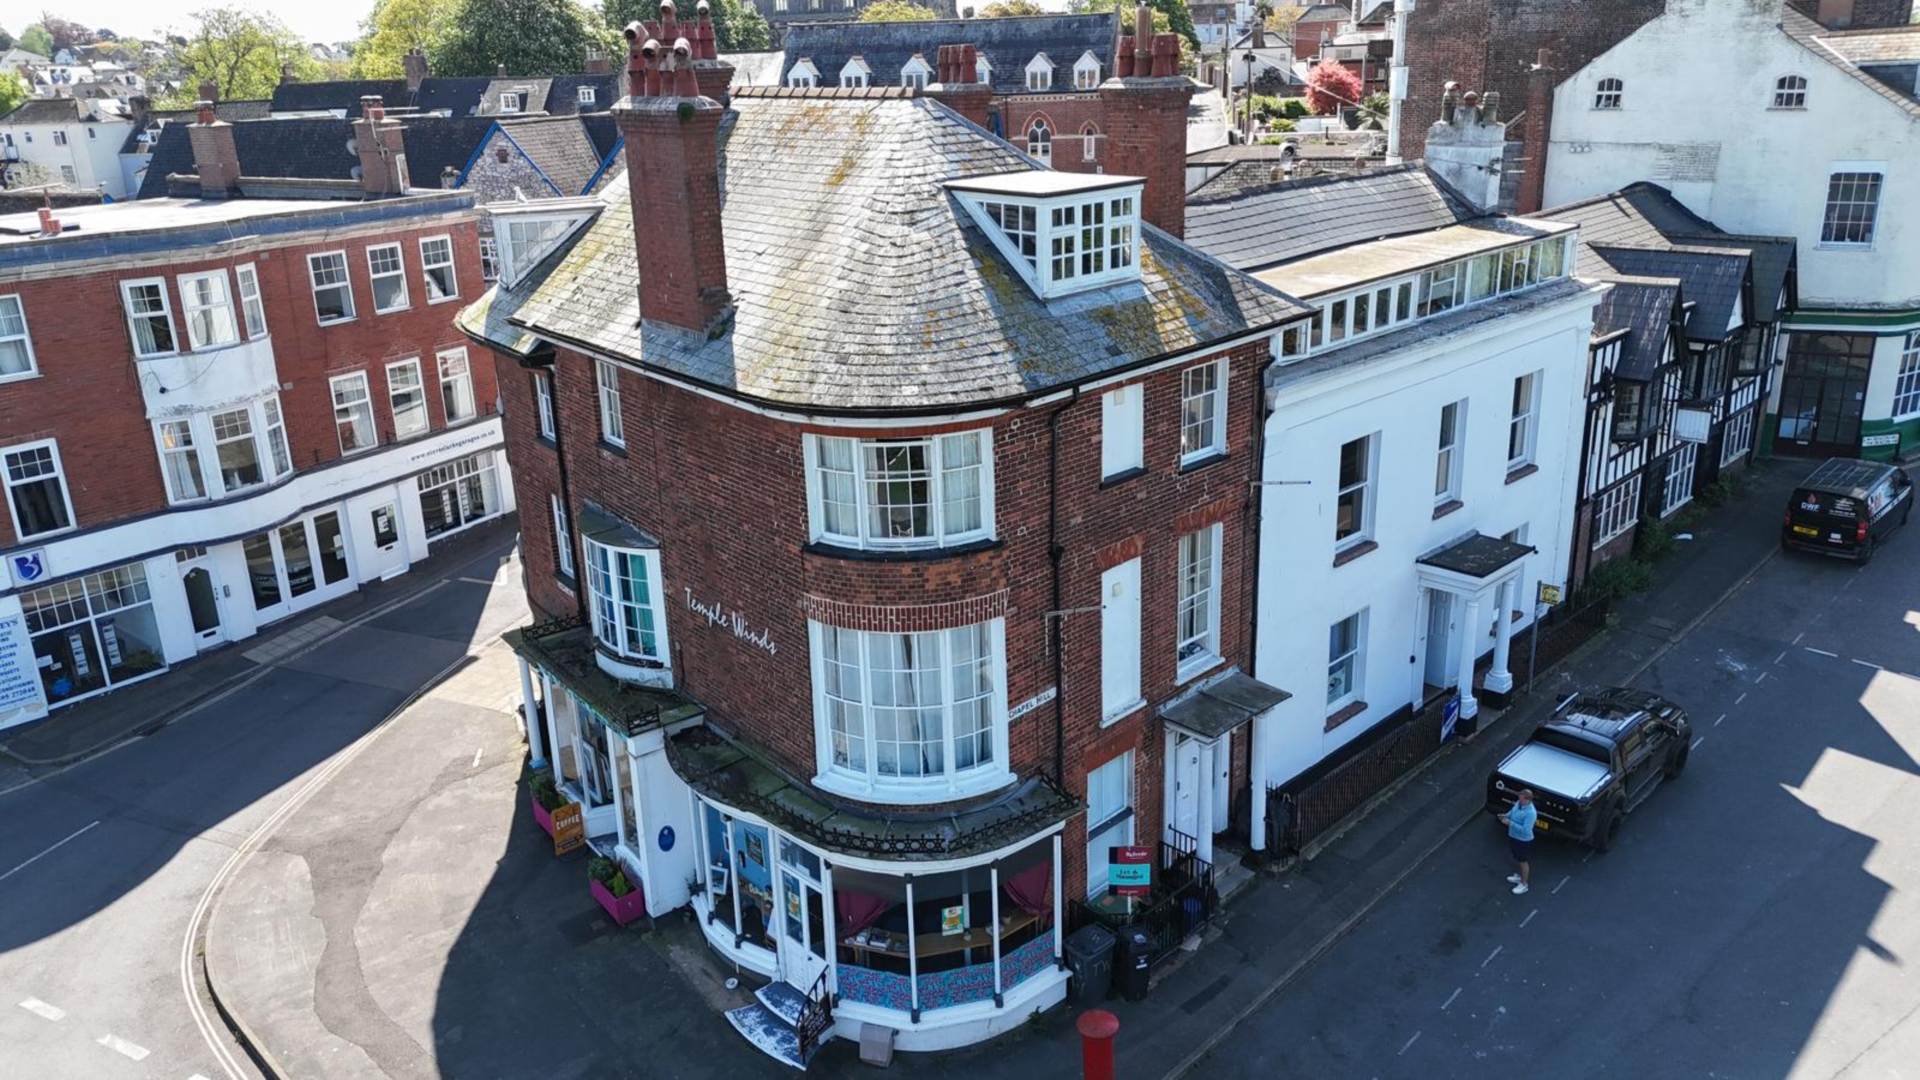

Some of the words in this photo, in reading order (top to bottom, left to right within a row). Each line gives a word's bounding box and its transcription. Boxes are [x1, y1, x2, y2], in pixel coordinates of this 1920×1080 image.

[684, 587, 729, 628] Temple
[731, 610, 778, 656] Winds
[1008, 701, 1034, 719] CHAPEL
[1036, 692, 1051, 705] HILL
[555, 814, 580, 831] COFFEE
